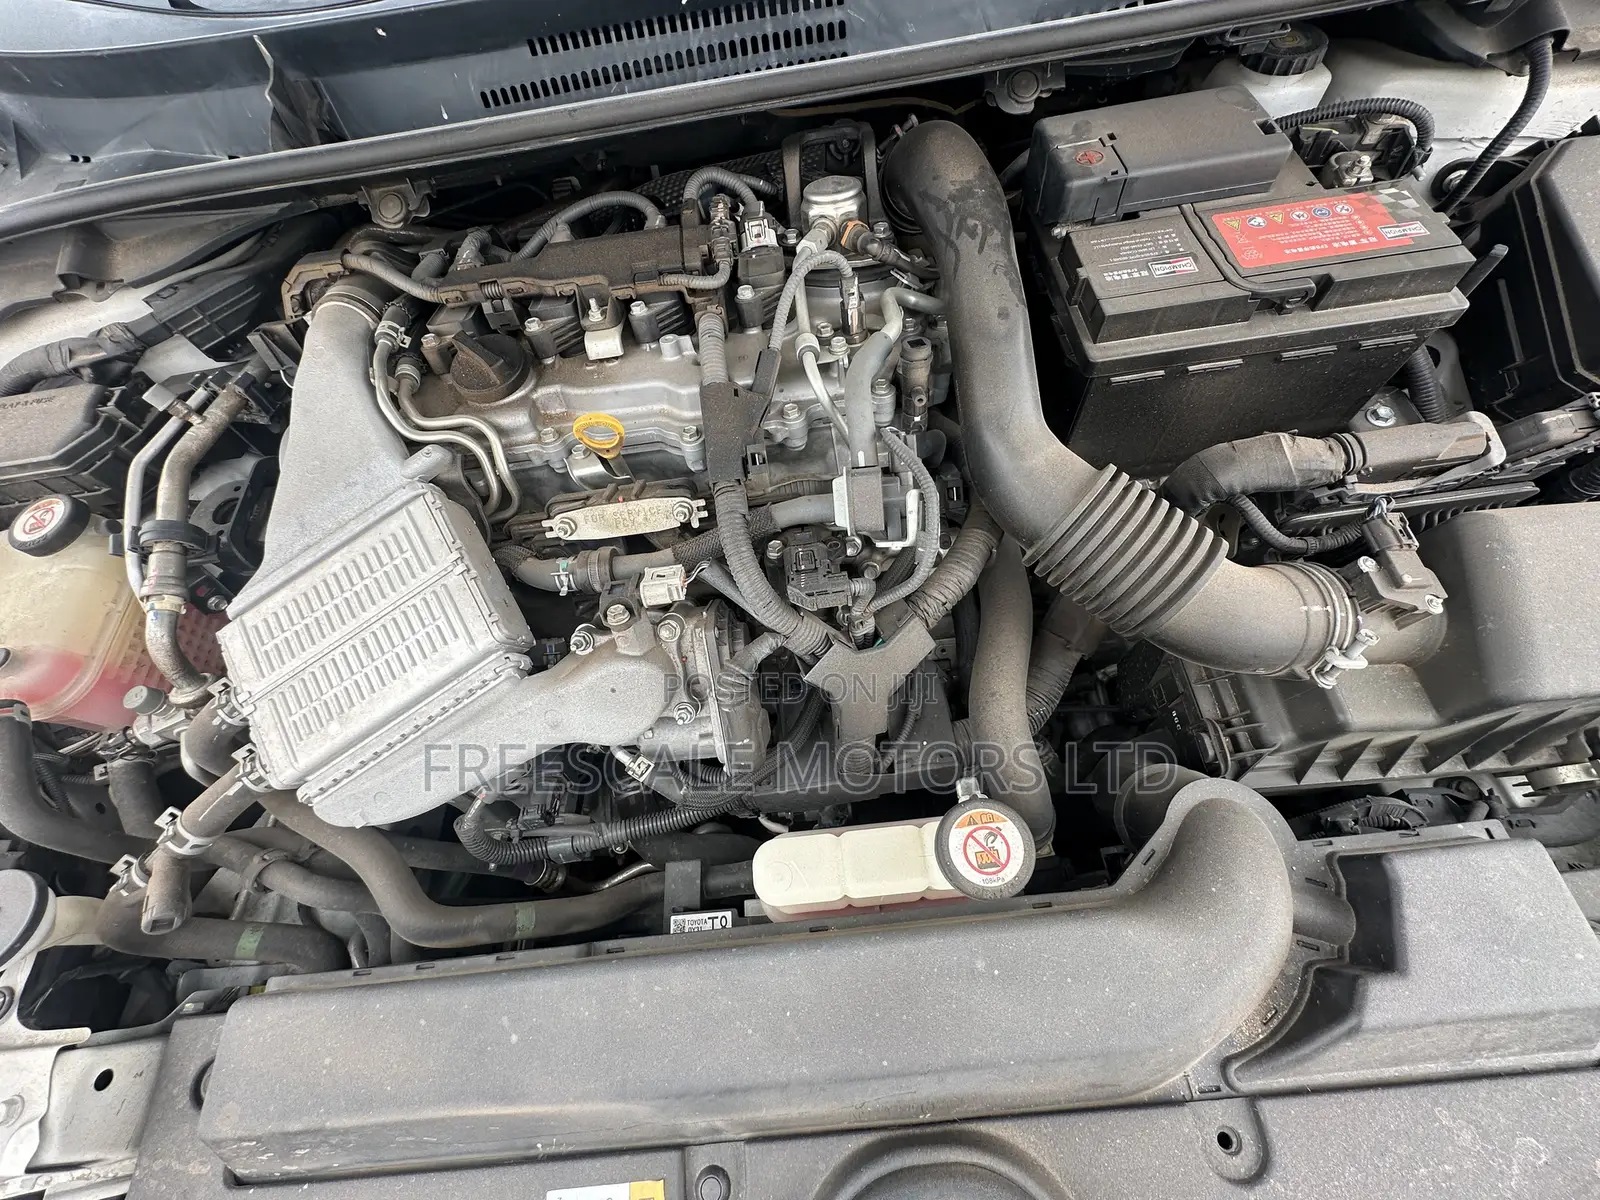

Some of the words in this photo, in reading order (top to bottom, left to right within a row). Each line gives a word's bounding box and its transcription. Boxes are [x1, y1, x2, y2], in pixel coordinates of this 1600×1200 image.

[1384, 224, 1422, 236] CHAMPION
[1154, 262, 1192, 272] CHAMPION
[584, 513, 605, 525] FOR
[612, 506, 663, 521] SERVICE
[687, 918, 708, 926] TOYOTA
